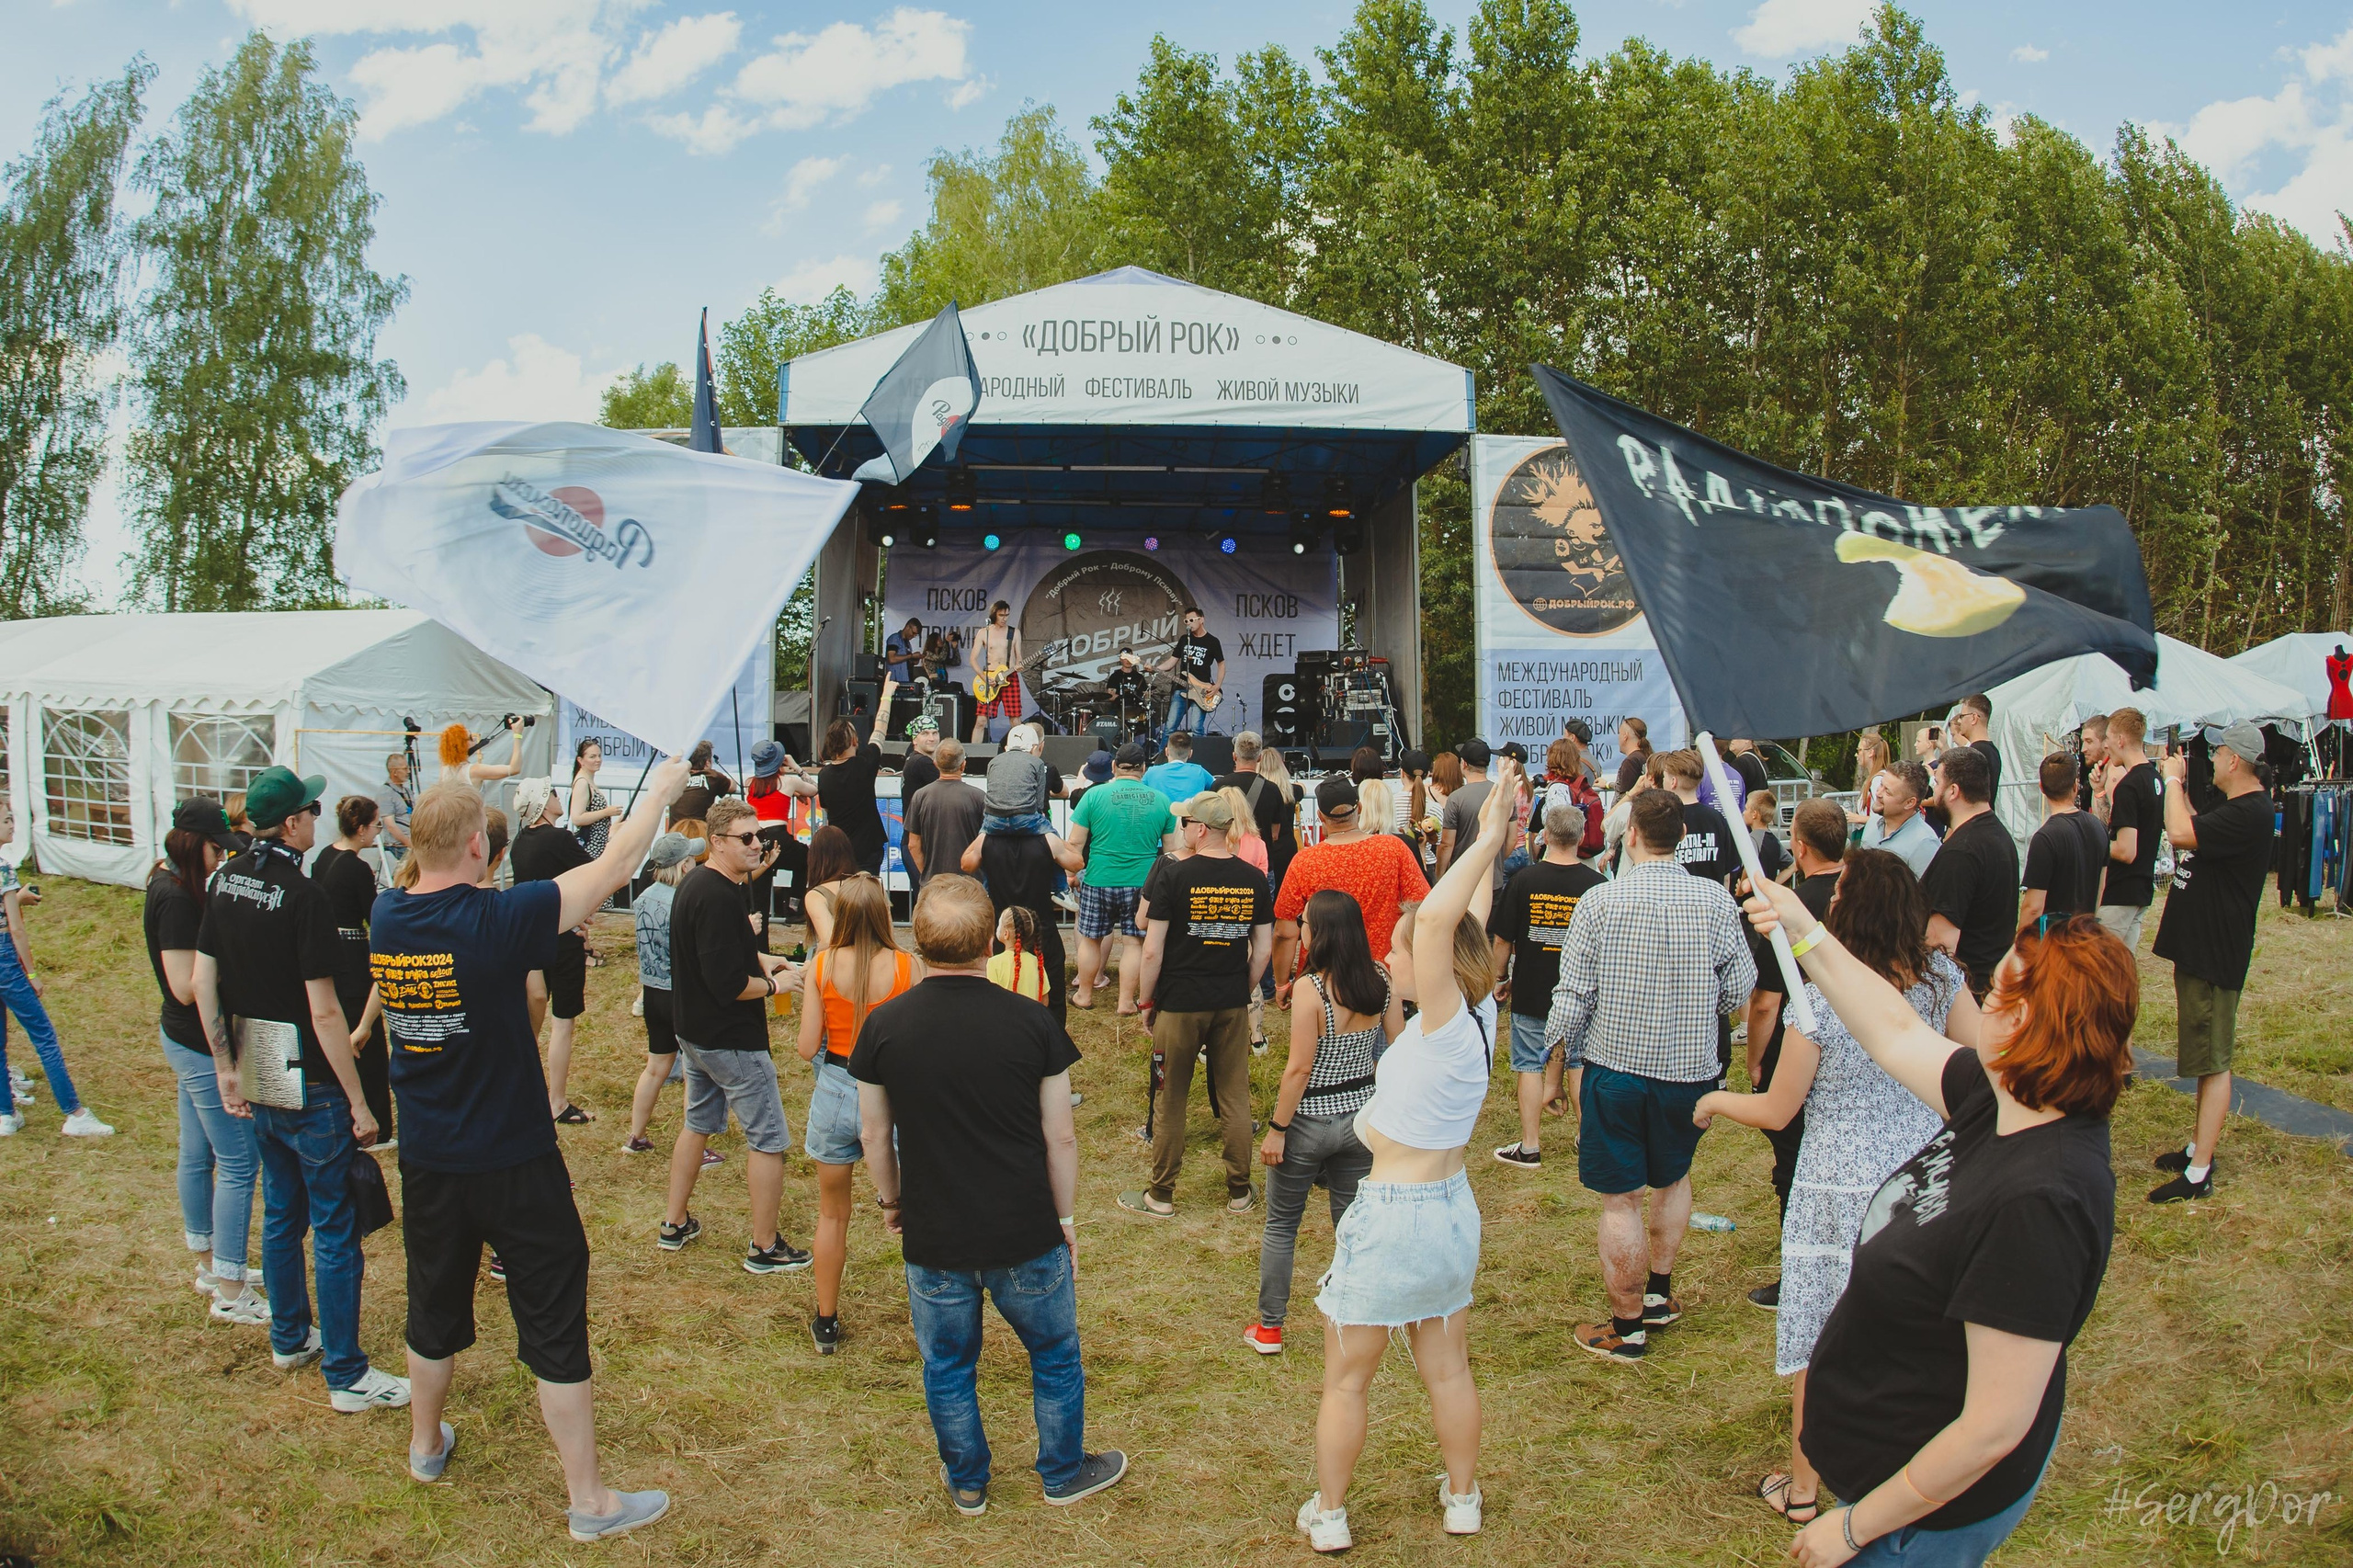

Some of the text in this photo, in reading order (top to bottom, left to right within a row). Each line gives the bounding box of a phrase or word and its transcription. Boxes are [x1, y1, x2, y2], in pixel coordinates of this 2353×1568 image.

[1022, 315, 1240, 356] «ДОБРЫЙ РОК»
[1085, 378, 1192, 399] ФЕСТИВАЛЬ
[1216, 377, 1279, 402] ЖИВОЙ
[1285, 381, 1359, 403] МУЗЫКИ
[1081, 564, 1099, 574] Рок
[1110, 562, 1154, 580] Доброму
[926, 588, 987, 611] ПСКОВ
[1236, 594, 1298, 619] ПСКОВ
[1548, 598, 1636, 610] ДОБРЫЙРОК.РФ
[1047, 609, 1179, 667] ДОБРЫЙ
[1238, 633, 1296, 659] ЖДЕТ
[1497, 657, 1643, 684] МЕЖДУНАРОДНЫЙ
[1498, 688, 1593, 710] ФЕСТИВАЛЬ
[1499, 712, 1555, 737] ЖИВОЙ
[1189, 886, 1255, 895] #ДОБРЫЙРОК2024
